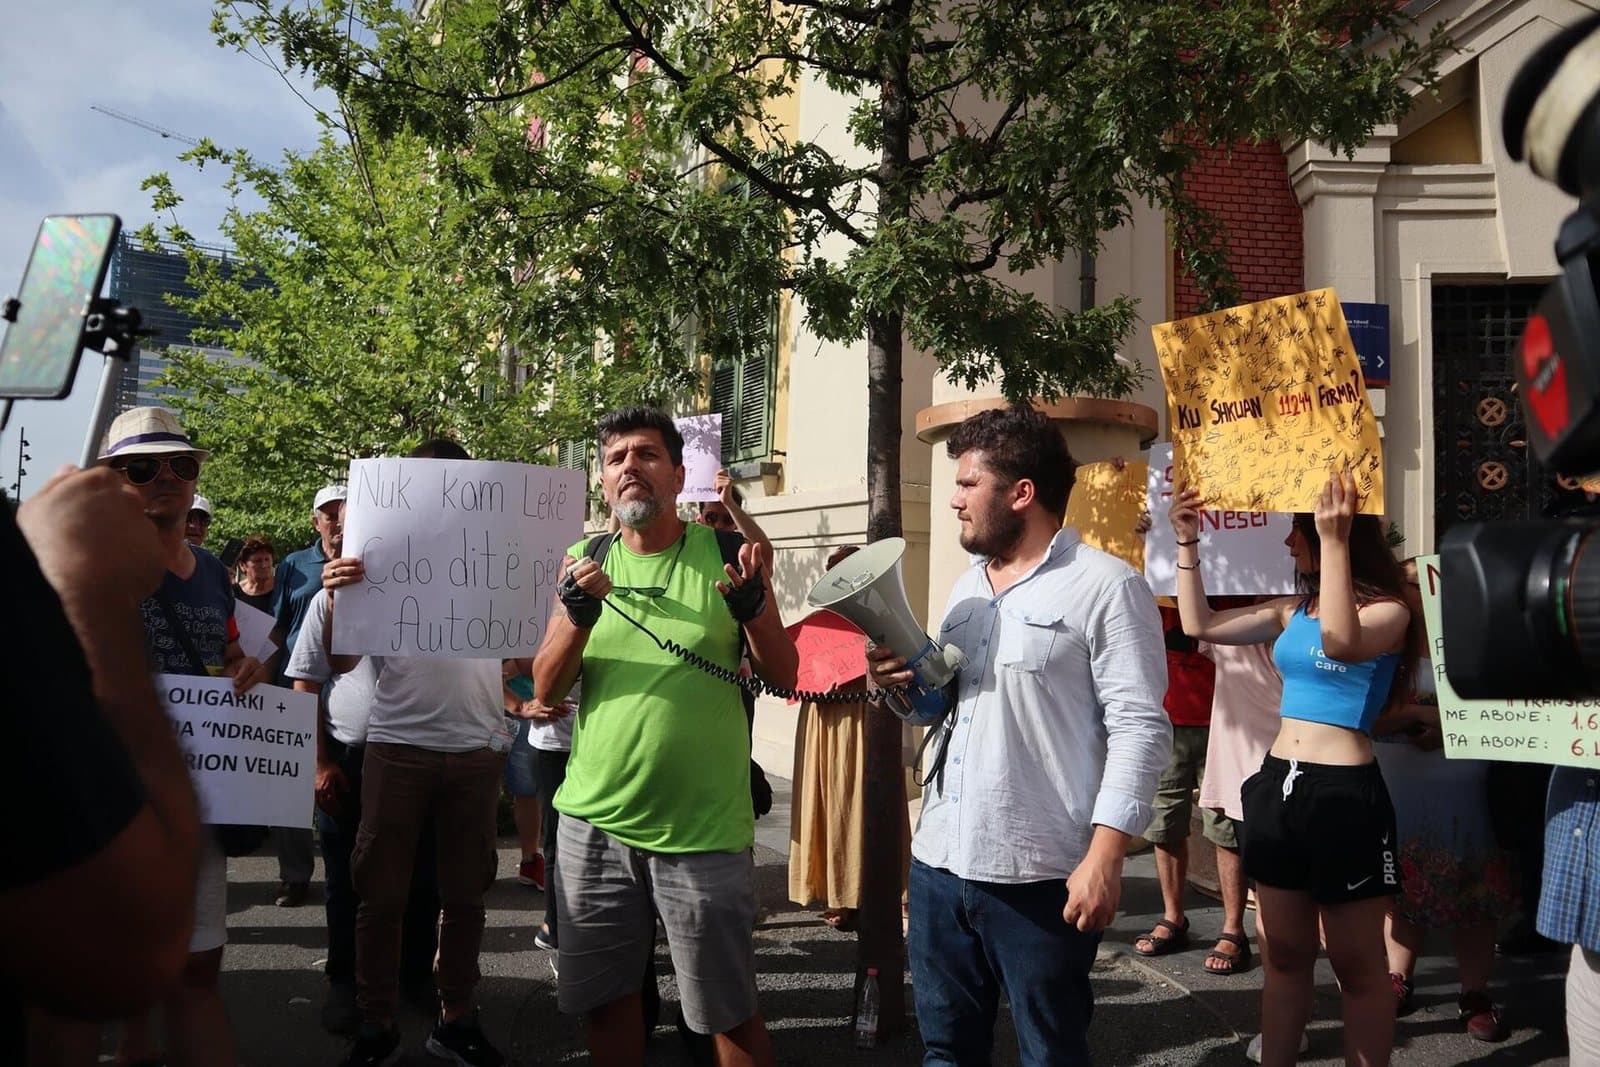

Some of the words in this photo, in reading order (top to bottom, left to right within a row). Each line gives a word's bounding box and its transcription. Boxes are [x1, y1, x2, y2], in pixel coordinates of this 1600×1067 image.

[1178, 403, 1202, 430] KU
[1210, 395, 1263, 426] SHKUAN
[1278, 391, 1313, 417] 11244
[357, 463, 412, 511] Nuk
[442, 468, 504, 513] kam
[523, 473, 568, 521] Lekë
[361, 534, 433, 595] Çdo
[449, 527, 521, 591] ditë
[1314, 660, 1347, 673] care
[168, 687, 264, 711] OLIGARKI
[1445, 709, 1468, 721] ME
[1480, 710, 1551, 722] ABONE:
[1446, 734, 1468, 748] PA
[1480, 735, 1549, 750] ABONE:
[244, 755, 300, 778] VELIAJ
[1383, 850, 1397, 885] PRO
